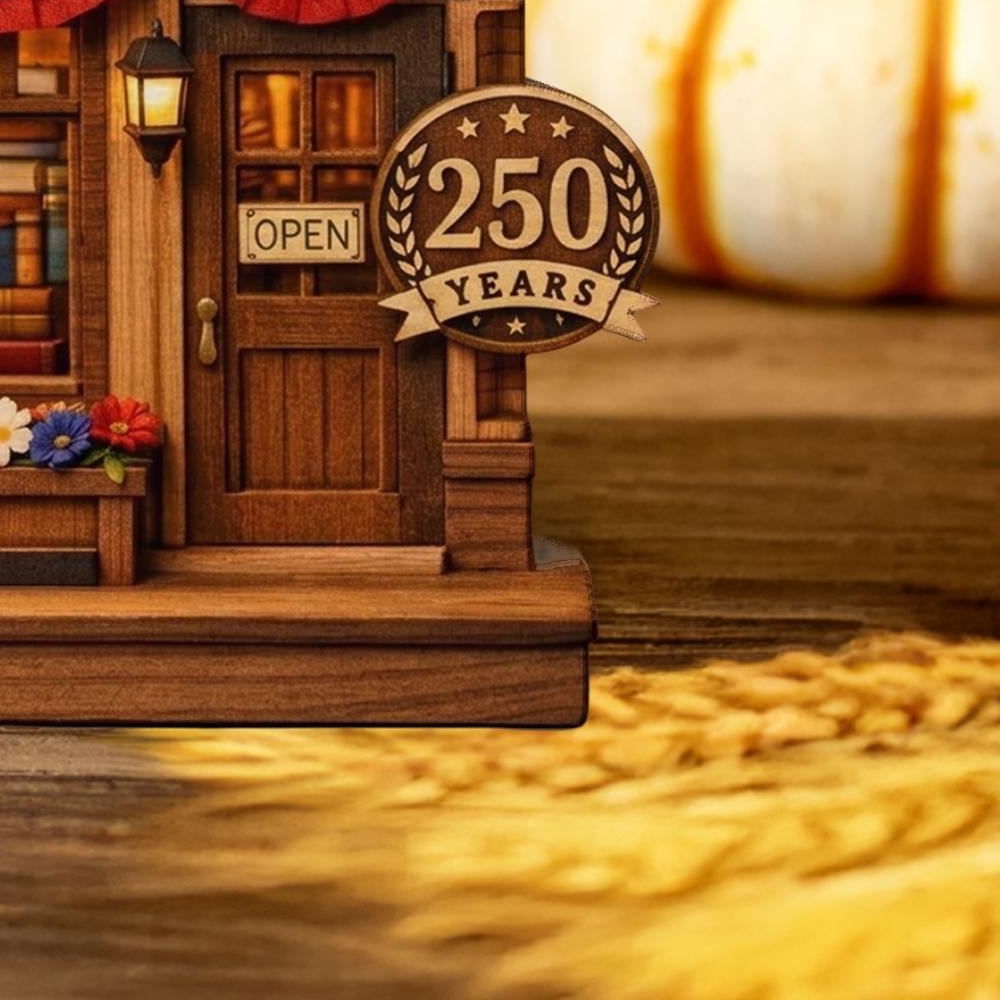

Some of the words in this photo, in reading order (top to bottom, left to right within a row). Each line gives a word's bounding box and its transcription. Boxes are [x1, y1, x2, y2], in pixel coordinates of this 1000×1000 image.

[424, 156, 610, 251] 250
[253, 217, 351, 251] OPEN
[444, 269, 597, 307] YEARS
